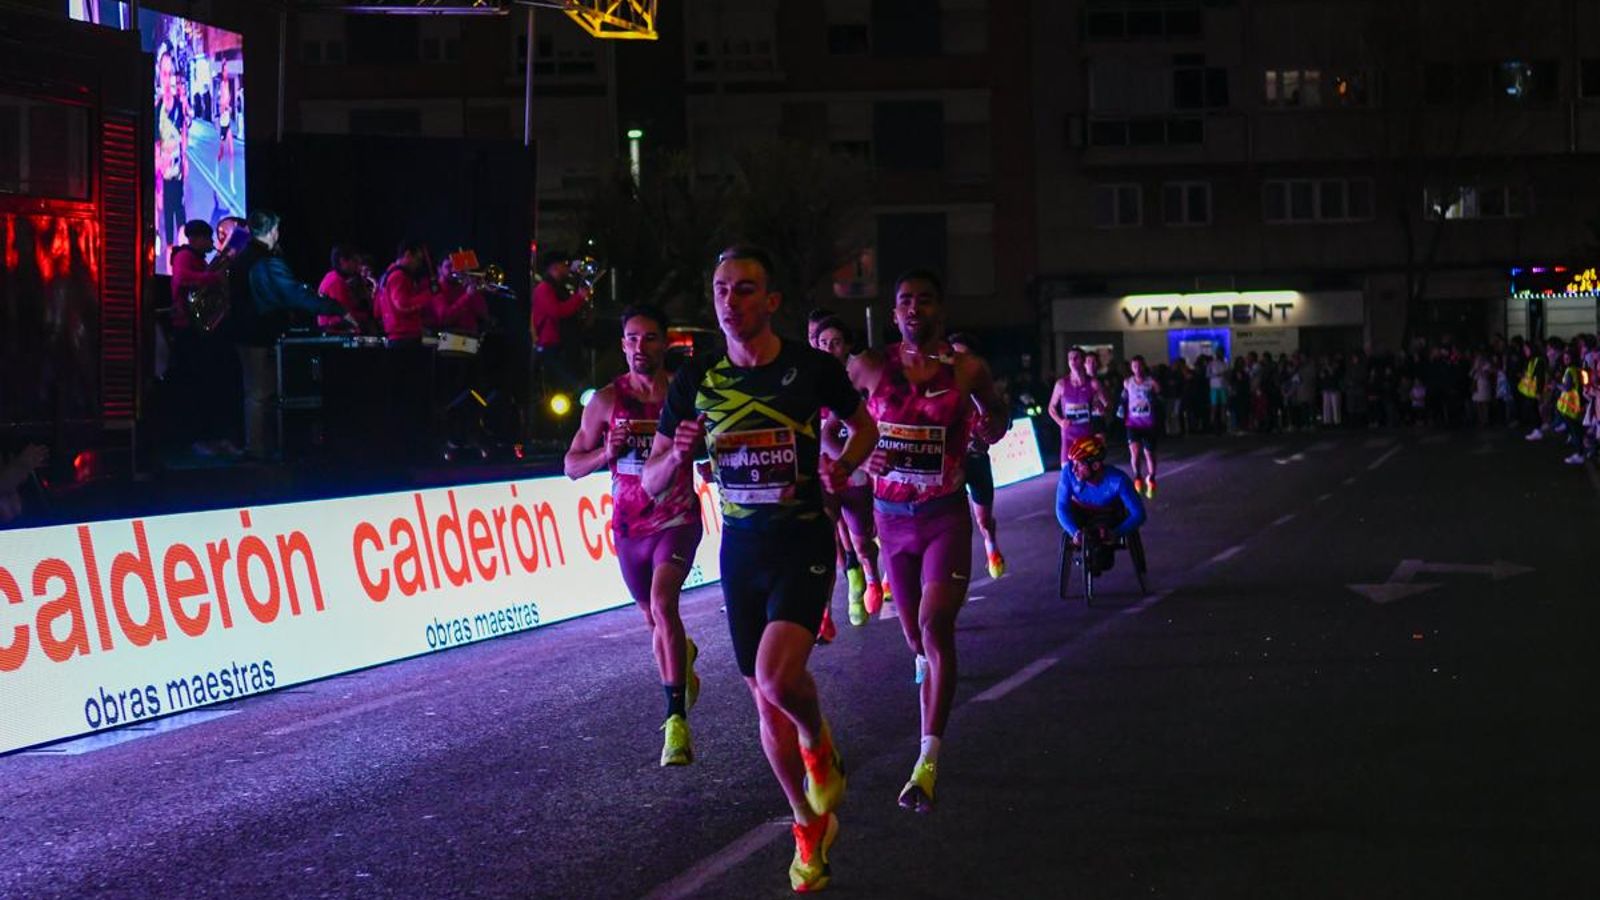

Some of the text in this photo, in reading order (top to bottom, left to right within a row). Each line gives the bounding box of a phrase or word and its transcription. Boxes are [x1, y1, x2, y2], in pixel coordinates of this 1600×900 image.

[1122, 303, 1294, 325] VITALDENT
[876, 439, 942, 455] OUKHELFEN
[718, 448, 794, 468] MENACHO
[904, 457, 912, 467] 2
[750, 469, 760, 482] 9
[426, 600, 540, 649] obras maestras
[84, 659, 276, 729] obras maestras
